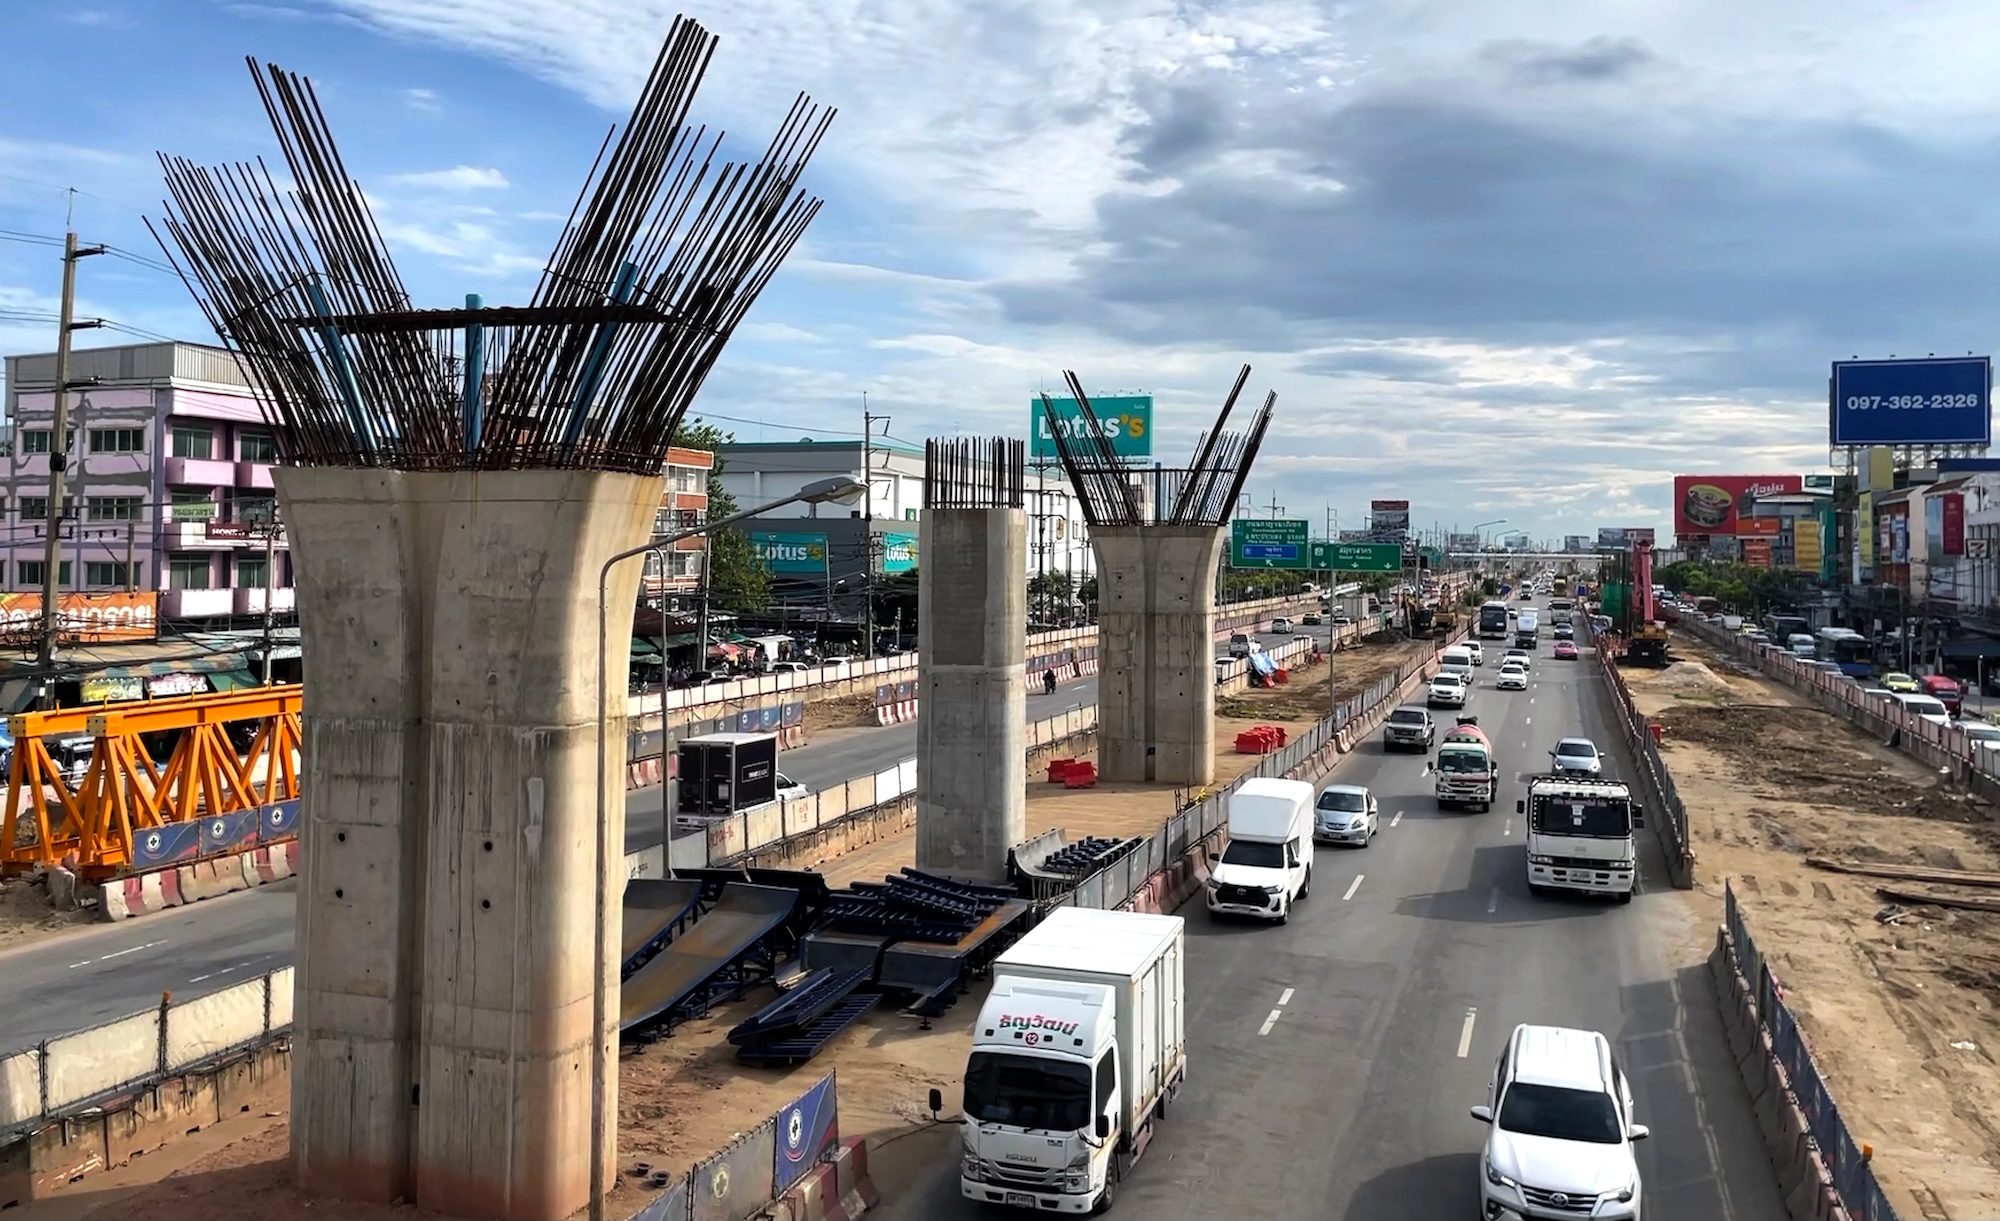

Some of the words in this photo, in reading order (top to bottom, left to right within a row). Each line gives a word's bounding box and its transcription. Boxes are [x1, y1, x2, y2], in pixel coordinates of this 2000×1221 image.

[1847, 394, 1978, 411] 097-362-2326
[754, 542, 824, 562] Lotus's
[1027, 1033, 1038, 1044] 12
